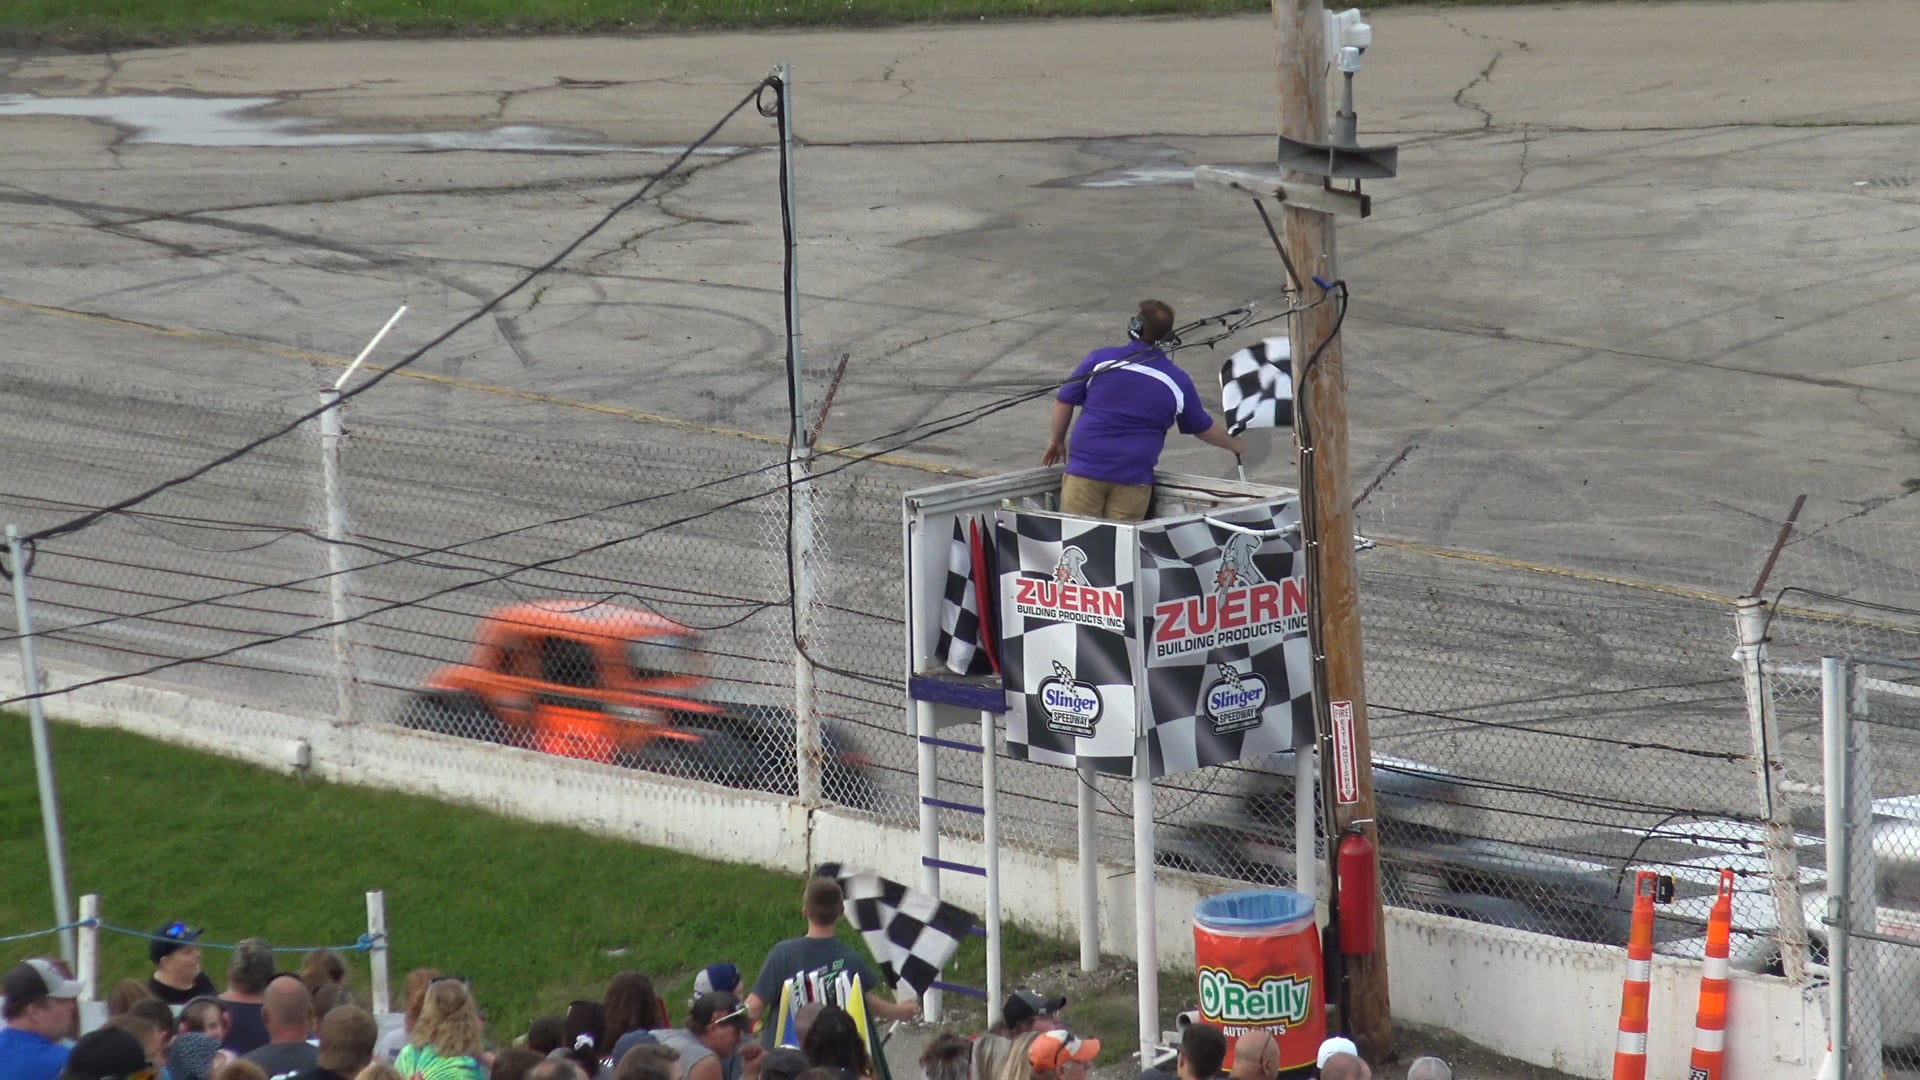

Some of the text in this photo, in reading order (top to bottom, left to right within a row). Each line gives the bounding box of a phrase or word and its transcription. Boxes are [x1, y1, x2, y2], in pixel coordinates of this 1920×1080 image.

[1016, 578, 1122, 618] ZUERN
[1156, 577, 1306, 642] ZUERN
[1017, 604, 1124, 628] BUILDING PRODUCTS, INC.
[1157, 634, 1215, 657] BUILDING
[1217, 620, 1286, 645] PRODUCTS,
[1045, 688, 1096, 712] Slinger
[1210, 687, 1263, 710] Slinger
[1053, 711, 1088, 726] SPEEDWAY
[1219, 708, 1255, 724] SPEEDWAY
[1333, 707, 1350, 719] FIRE
[1339, 719, 1352, 795] EXTINGUISHER
[1200, 973, 1306, 1018] O'Reilly
